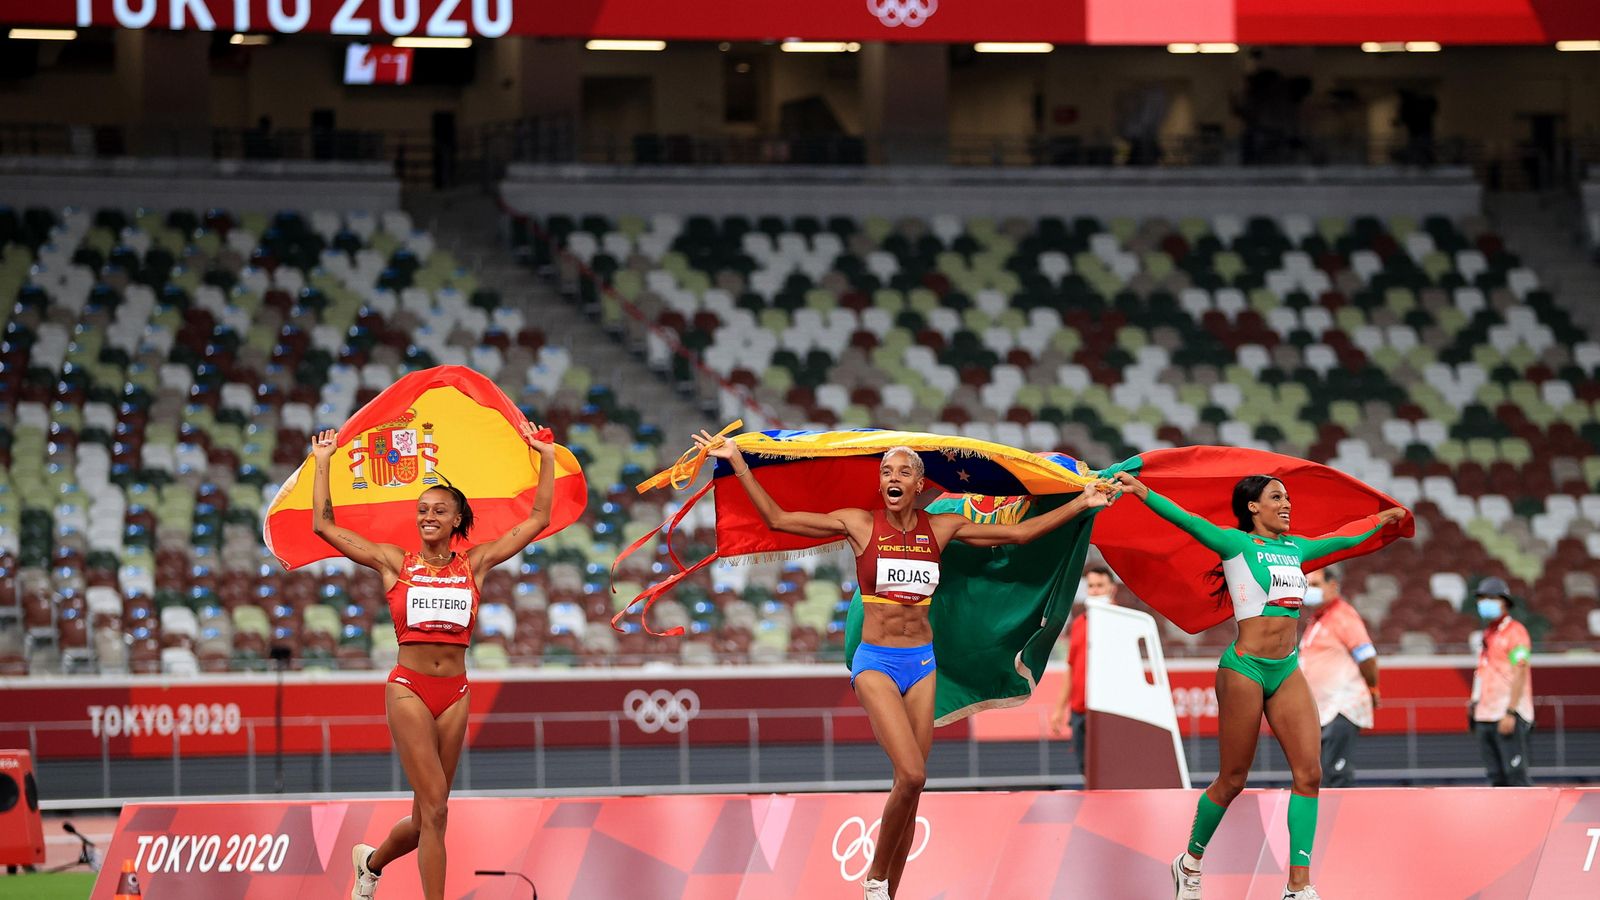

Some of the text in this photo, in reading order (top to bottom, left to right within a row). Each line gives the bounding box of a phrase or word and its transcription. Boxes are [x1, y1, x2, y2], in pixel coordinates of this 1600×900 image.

[877, 545, 932, 553] VENEZUELA
[887, 568, 931, 584] ROJAS
[412, 598, 467, 610] PELETEIRO
[87, 703, 241, 737] TOKYO 2020
[134, 833, 290, 873] TOKYO 2020
